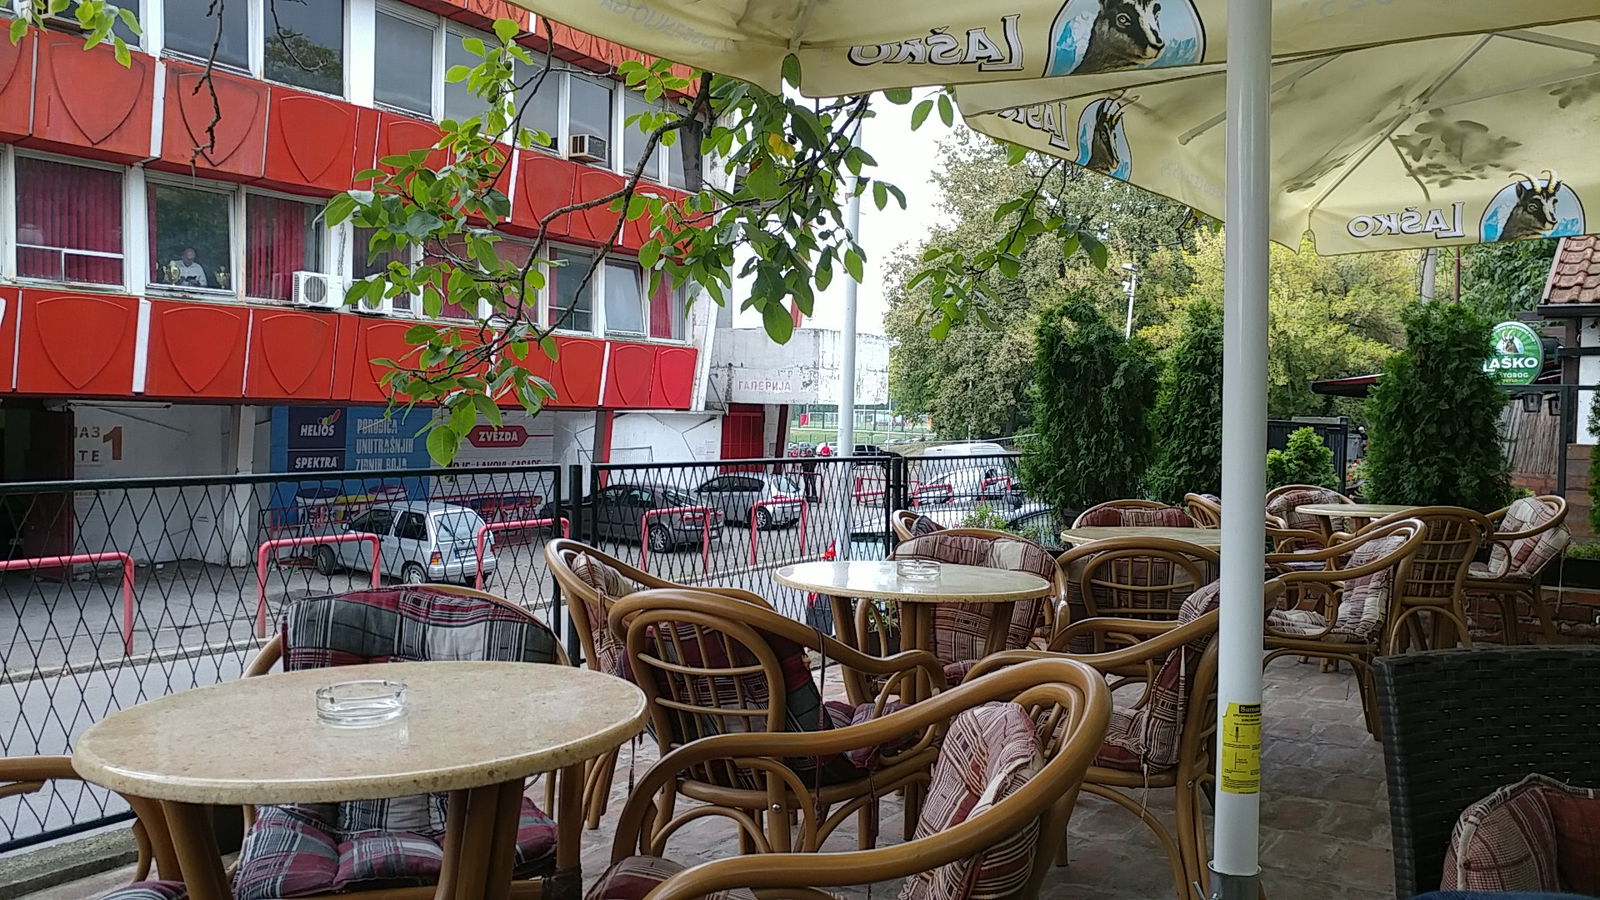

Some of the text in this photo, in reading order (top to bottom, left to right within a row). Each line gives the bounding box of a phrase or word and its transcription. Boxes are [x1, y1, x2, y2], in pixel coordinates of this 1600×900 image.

[1483, 356, 1538, 372] LAŠKO
[738, 380, 791, 391] ГАЛЕРИЈА
[300, 424, 335, 437] HELIOS
[479, 431, 518, 442] ZVEZDA
[103, 426, 122, 460] 1
[356, 436, 414, 454] UNUTRAŠNJIH
[295, 456, 338, 469] SPEKTRA
